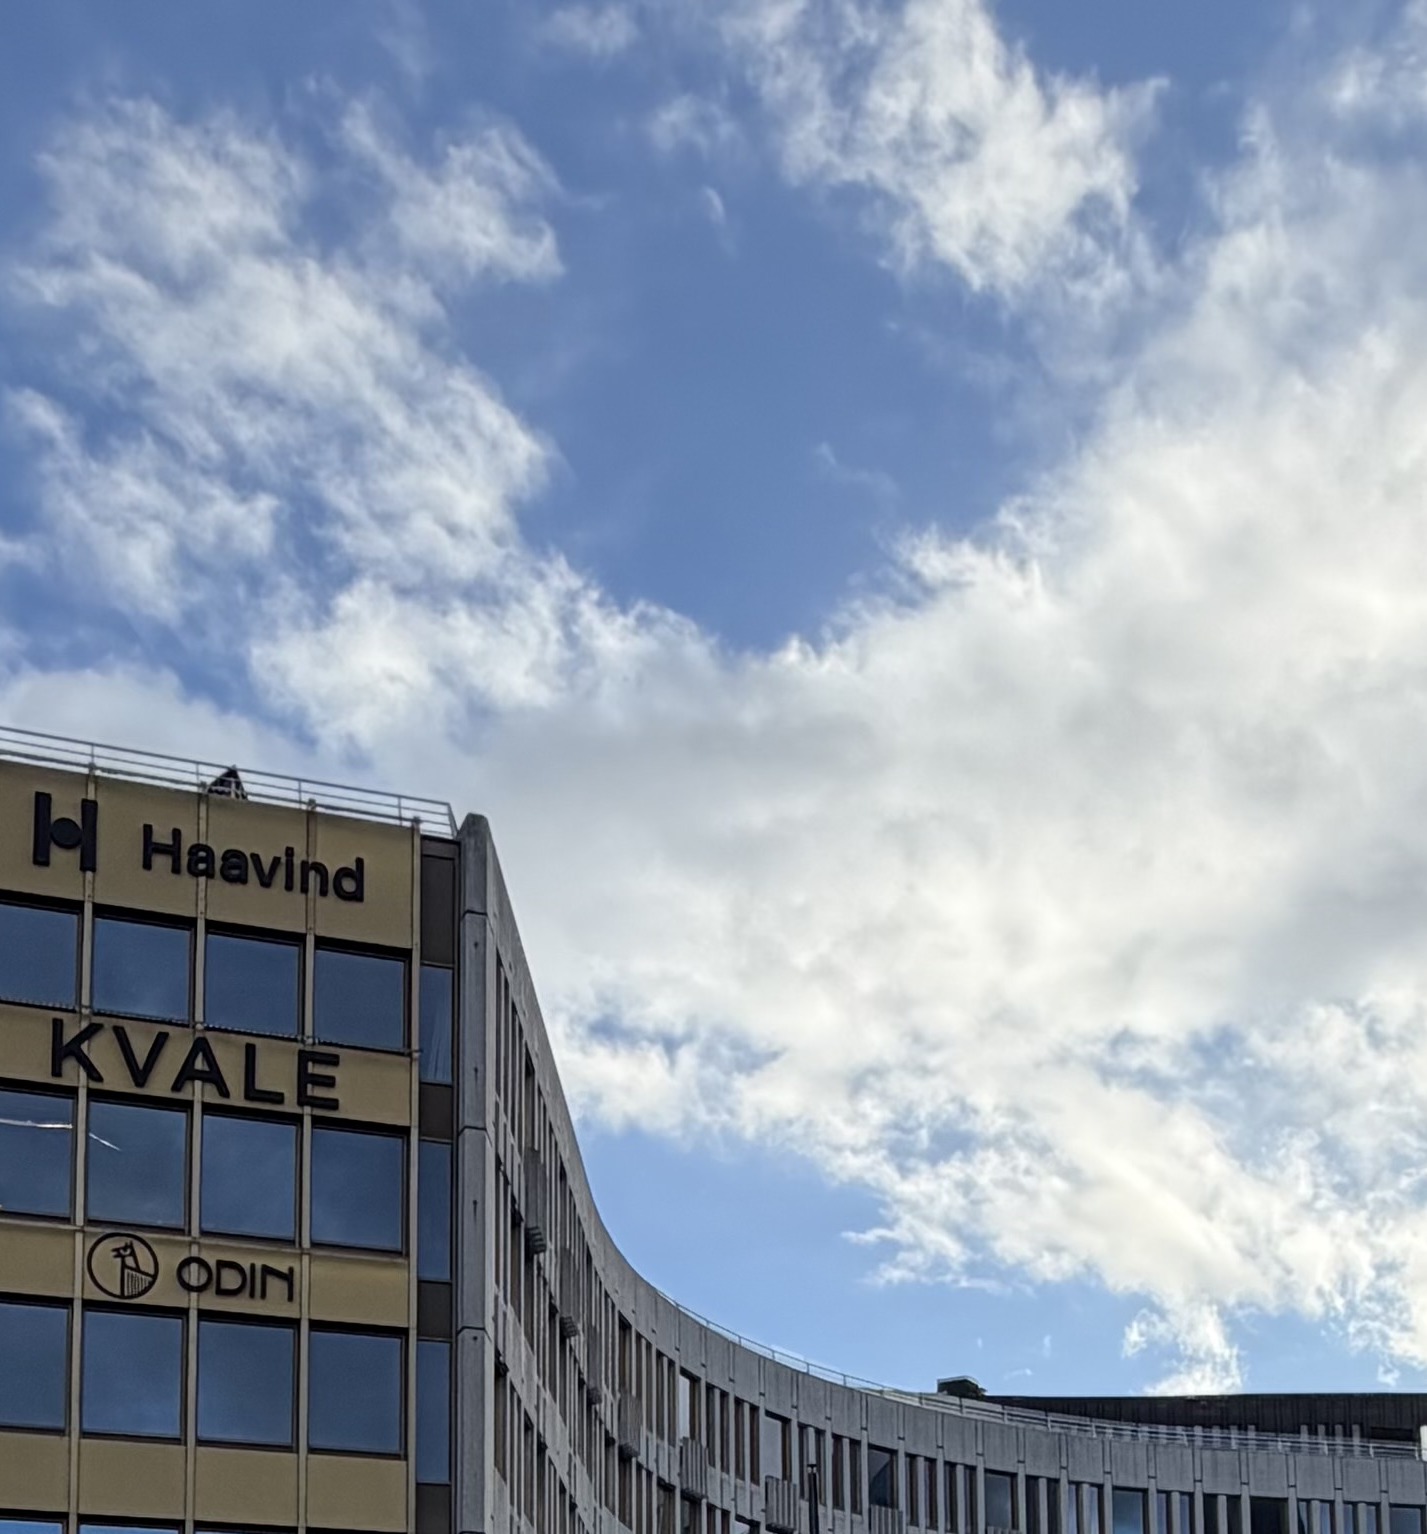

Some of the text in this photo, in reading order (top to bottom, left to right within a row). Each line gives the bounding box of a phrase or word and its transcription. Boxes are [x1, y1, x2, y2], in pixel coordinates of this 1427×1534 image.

[142, 823, 366, 902] Haavind
[51, 1018, 340, 1110] KVALE
[177, 1255, 295, 1303] ODIN
